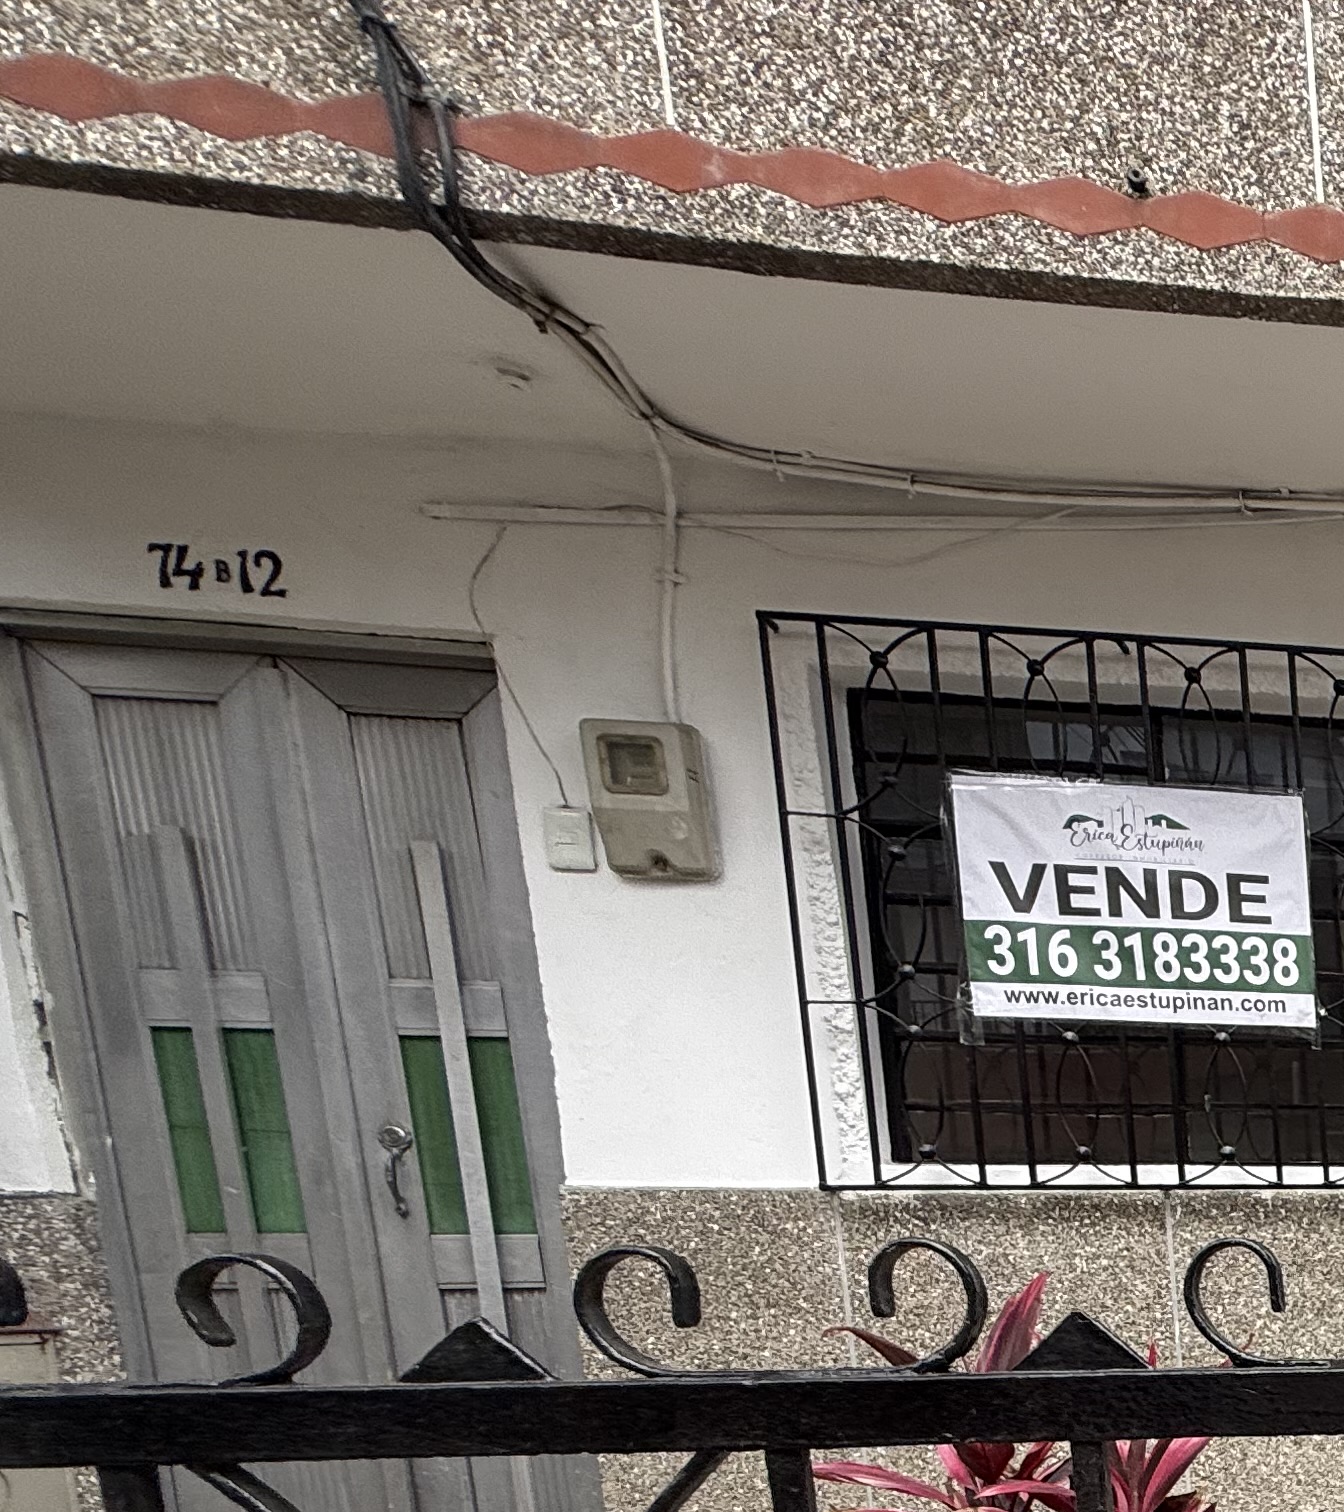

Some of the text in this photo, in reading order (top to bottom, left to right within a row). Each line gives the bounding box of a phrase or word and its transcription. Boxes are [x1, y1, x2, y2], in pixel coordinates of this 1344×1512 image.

[988, 860, 1273, 925] VENDE
[983, 925, 1300, 987] 316 3183338
[1004, 988, 1287, 1014] www.ericaestupinan.com
